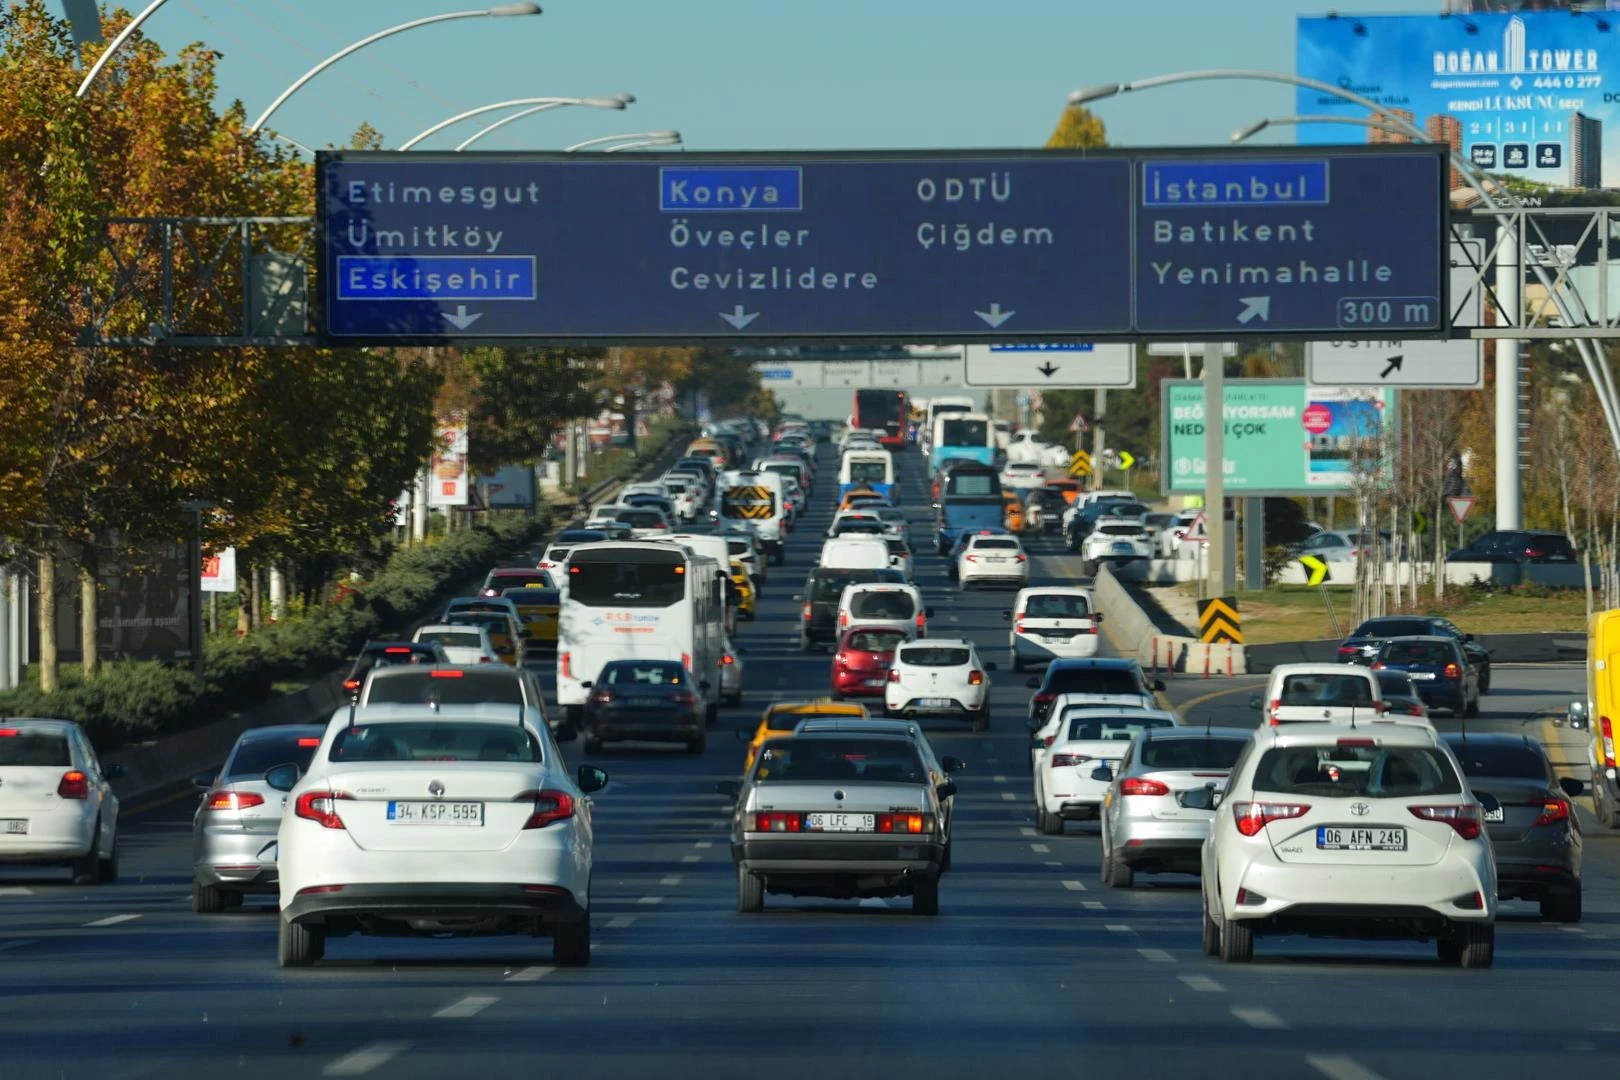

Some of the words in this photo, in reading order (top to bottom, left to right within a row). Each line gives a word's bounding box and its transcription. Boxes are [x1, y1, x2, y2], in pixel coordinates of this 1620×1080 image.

[1433, 48, 1498, 73] DOĞAN
[1529, 49, 1598, 72] TOWER
[1533, 77, 1560, 88] 444
[1564, 77, 1574, 88] 0
[1577, 75, 1601, 88] 277
[348, 180, 541, 208] Etimesgut
[671, 180, 780, 209] Konya
[917, 171, 1012, 202] ODTÜ
[1152, 169, 1308, 200] İstanbul
[347, 218, 504, 252] Ümitköy
[670, 218, 810, 251] Öveçler
[917, 222, 1055, 252] Çiğdem
[1153, 219, 1316, 244] Batıkent
[348, 266, 521, 293] Eskişehir
[670, 266, 879, 291] Cevizlidere
[1151, 258, 1393, 285] Yenimahalle
[1344, 302, 1391, 323] 300
[1404, 305, 1430, 323] m
[397, 804, 413, 820] 34
[421, 804, 446, 820] KSP
[453, 804, 478, 820] 595
[811, 814, 823, 826] 06
[830, 815, 848, 826] LFC
[862, 815, 873, 827] 19
[1326, 829, 1342, 843] 06
[1350, 830, 1373, 844] AFN
[1379, 830, 1401, 844] 245
